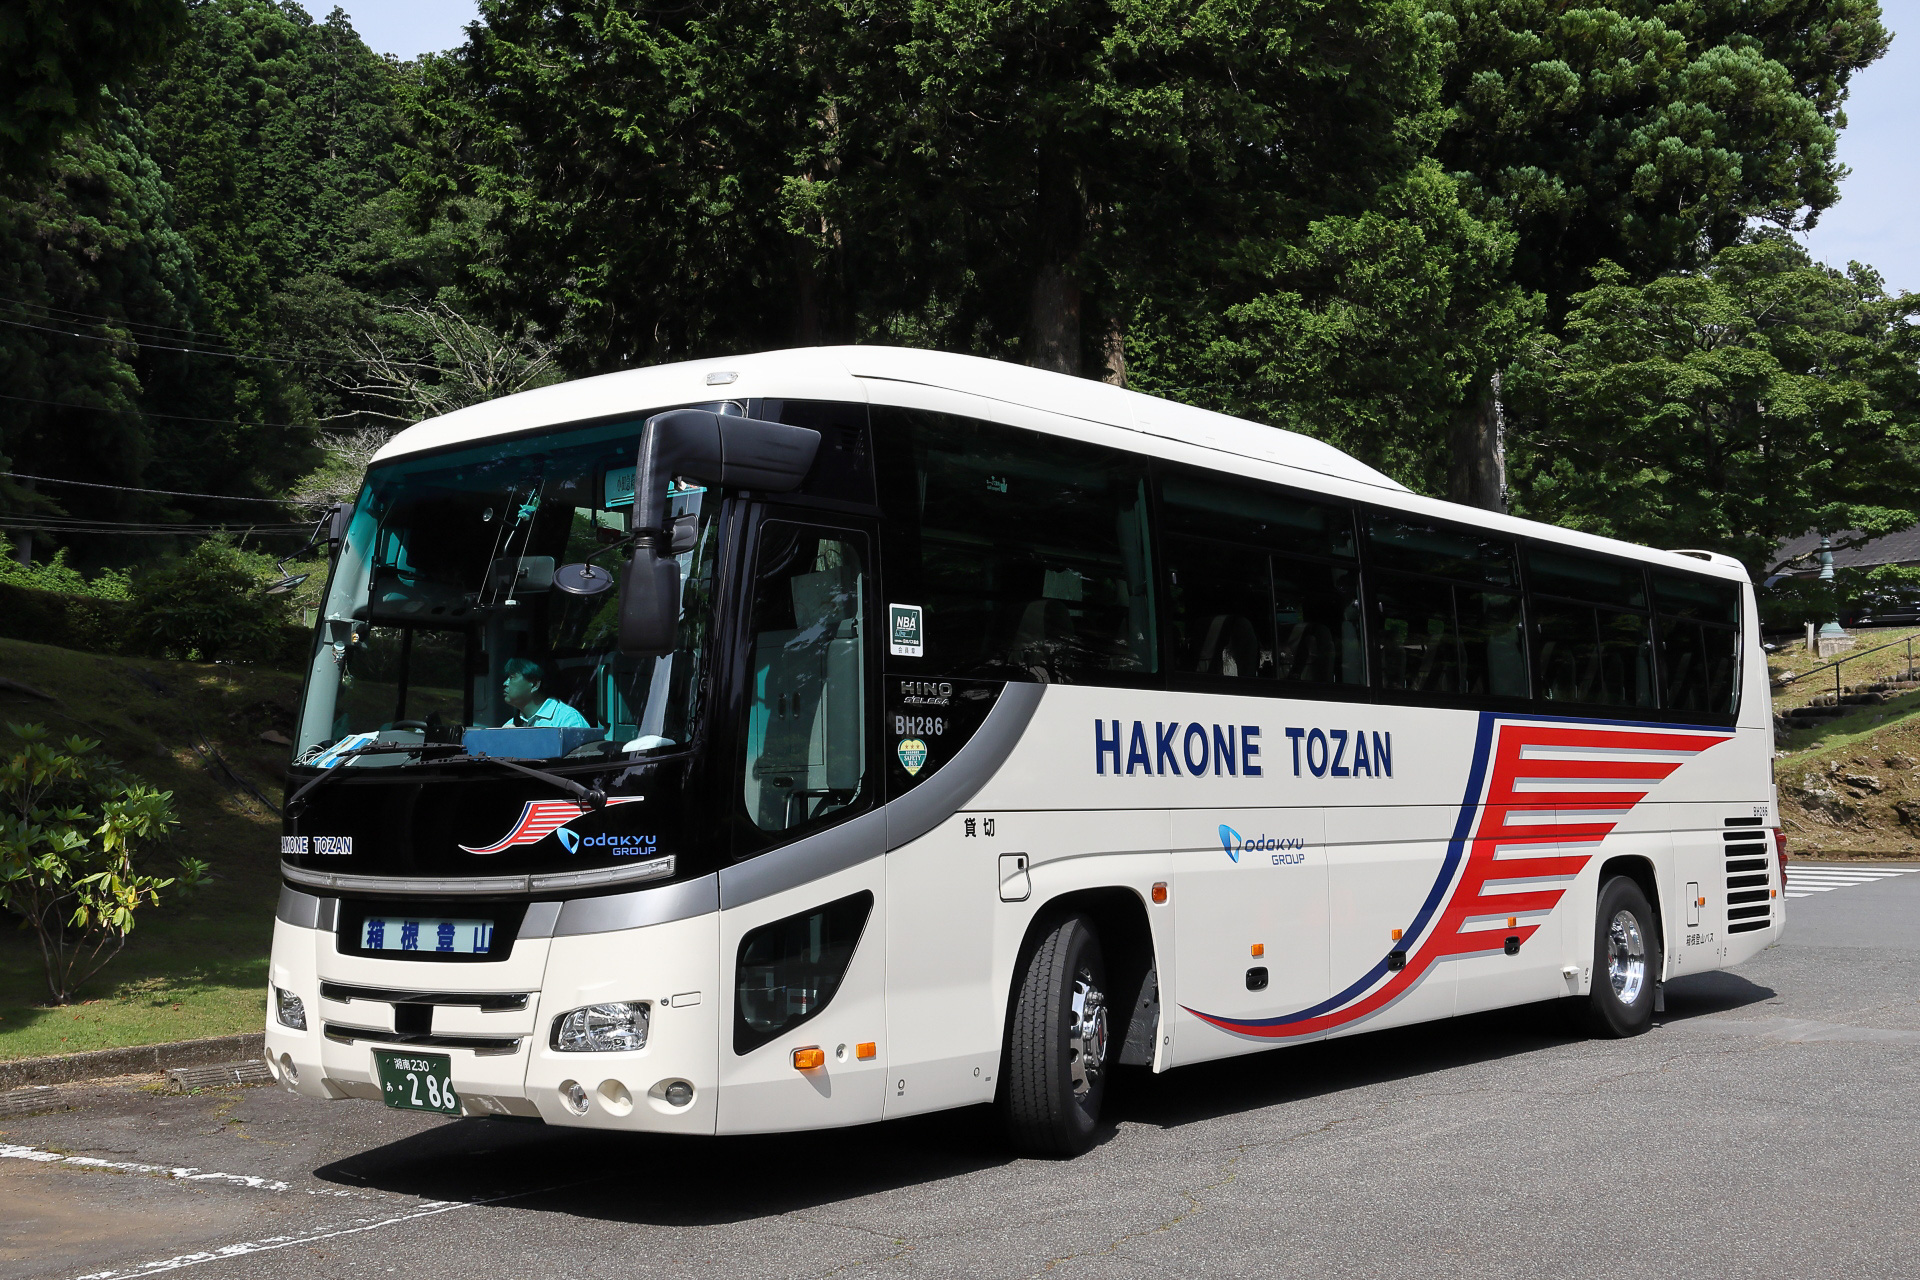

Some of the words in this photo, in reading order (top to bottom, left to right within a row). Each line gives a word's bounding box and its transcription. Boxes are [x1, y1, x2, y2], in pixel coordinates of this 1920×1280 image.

[896, 616, 916, 628] NBA
[901, 681, 952, 696] HINO
[895, 715, 943, 736] BH286
[1094, 718, 1263, 778] HAKONE
[1285, 726, 1394, 779] TOZAN
[964, 817, 995, 837] 貸切
[281, 836, 309, 854] AKONE
[313, 836, 352, 854] TOZAN
[612, 847, 656, 856] GROUP
[1271, 854, 1305, 865] GROUP
